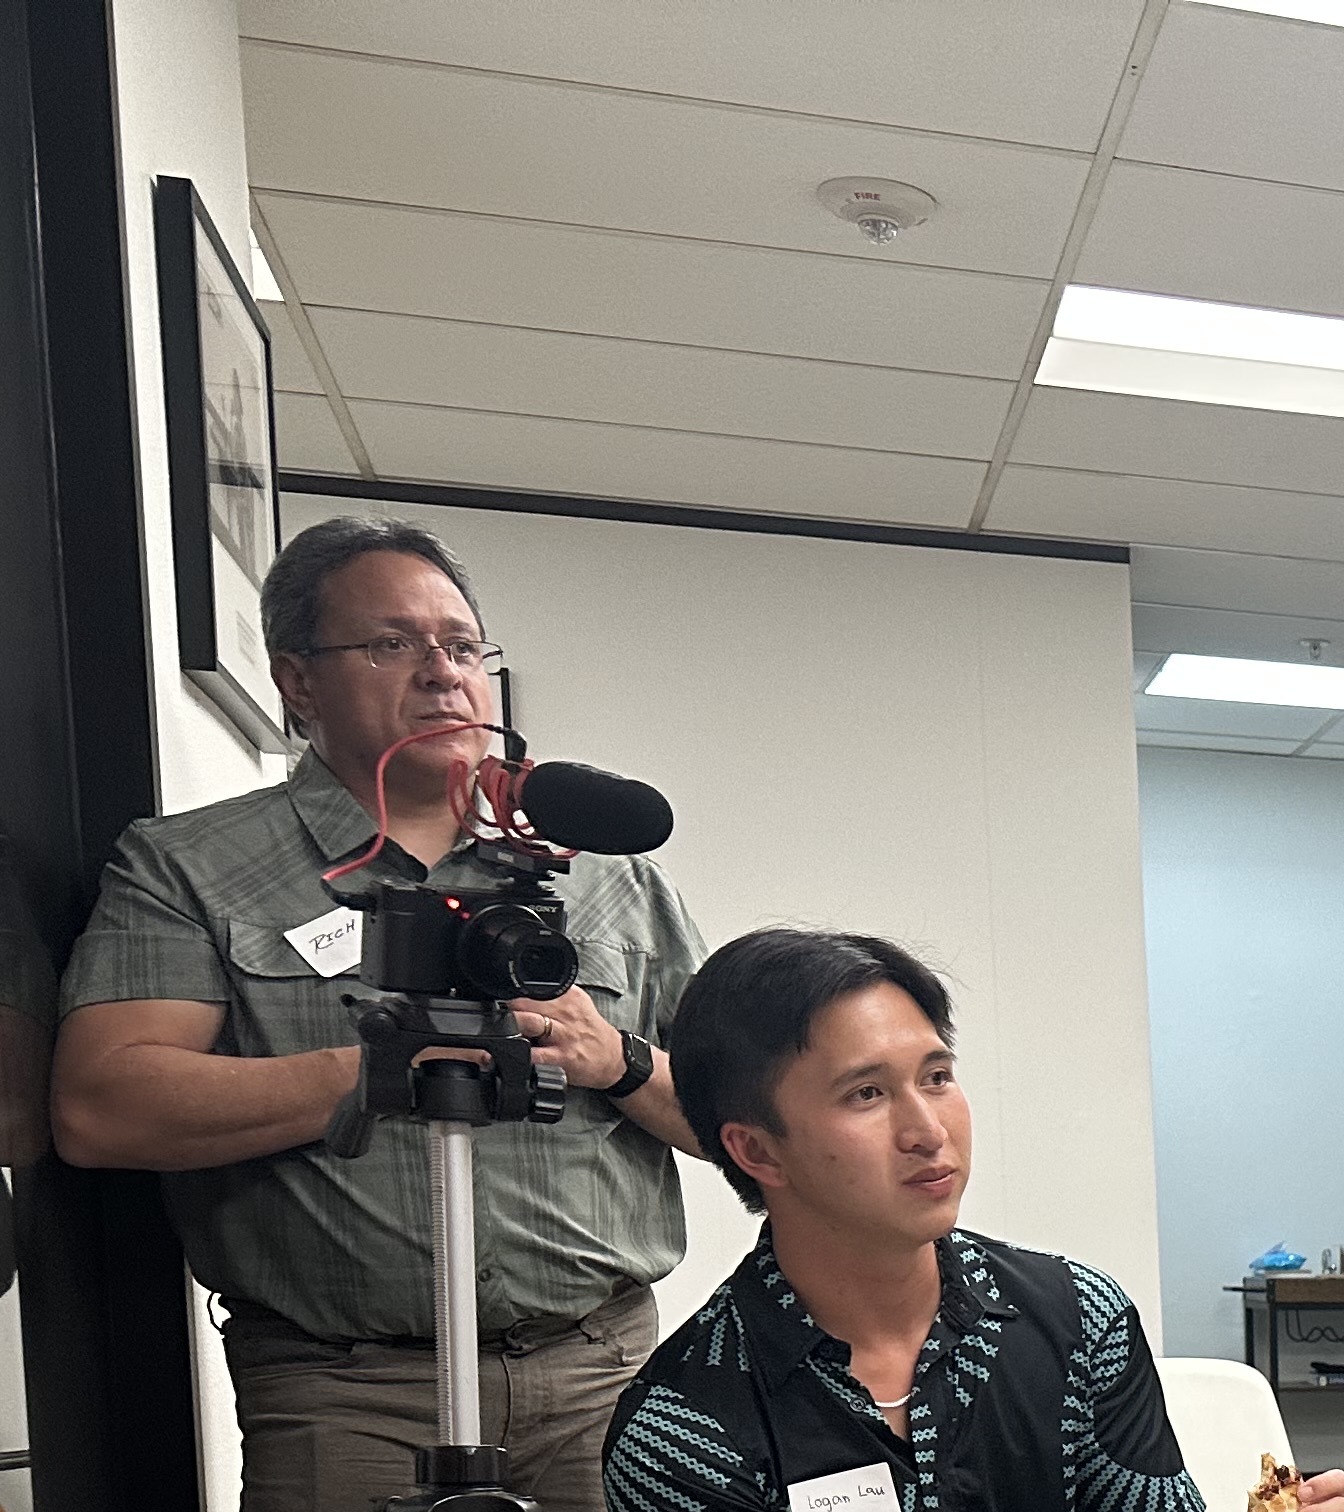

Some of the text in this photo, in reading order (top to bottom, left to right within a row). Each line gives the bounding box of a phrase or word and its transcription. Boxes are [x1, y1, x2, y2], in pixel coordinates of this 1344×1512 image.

[308, 919, 355, 954] RICH
[807, 1485, 885, 1512] Logan Lau
